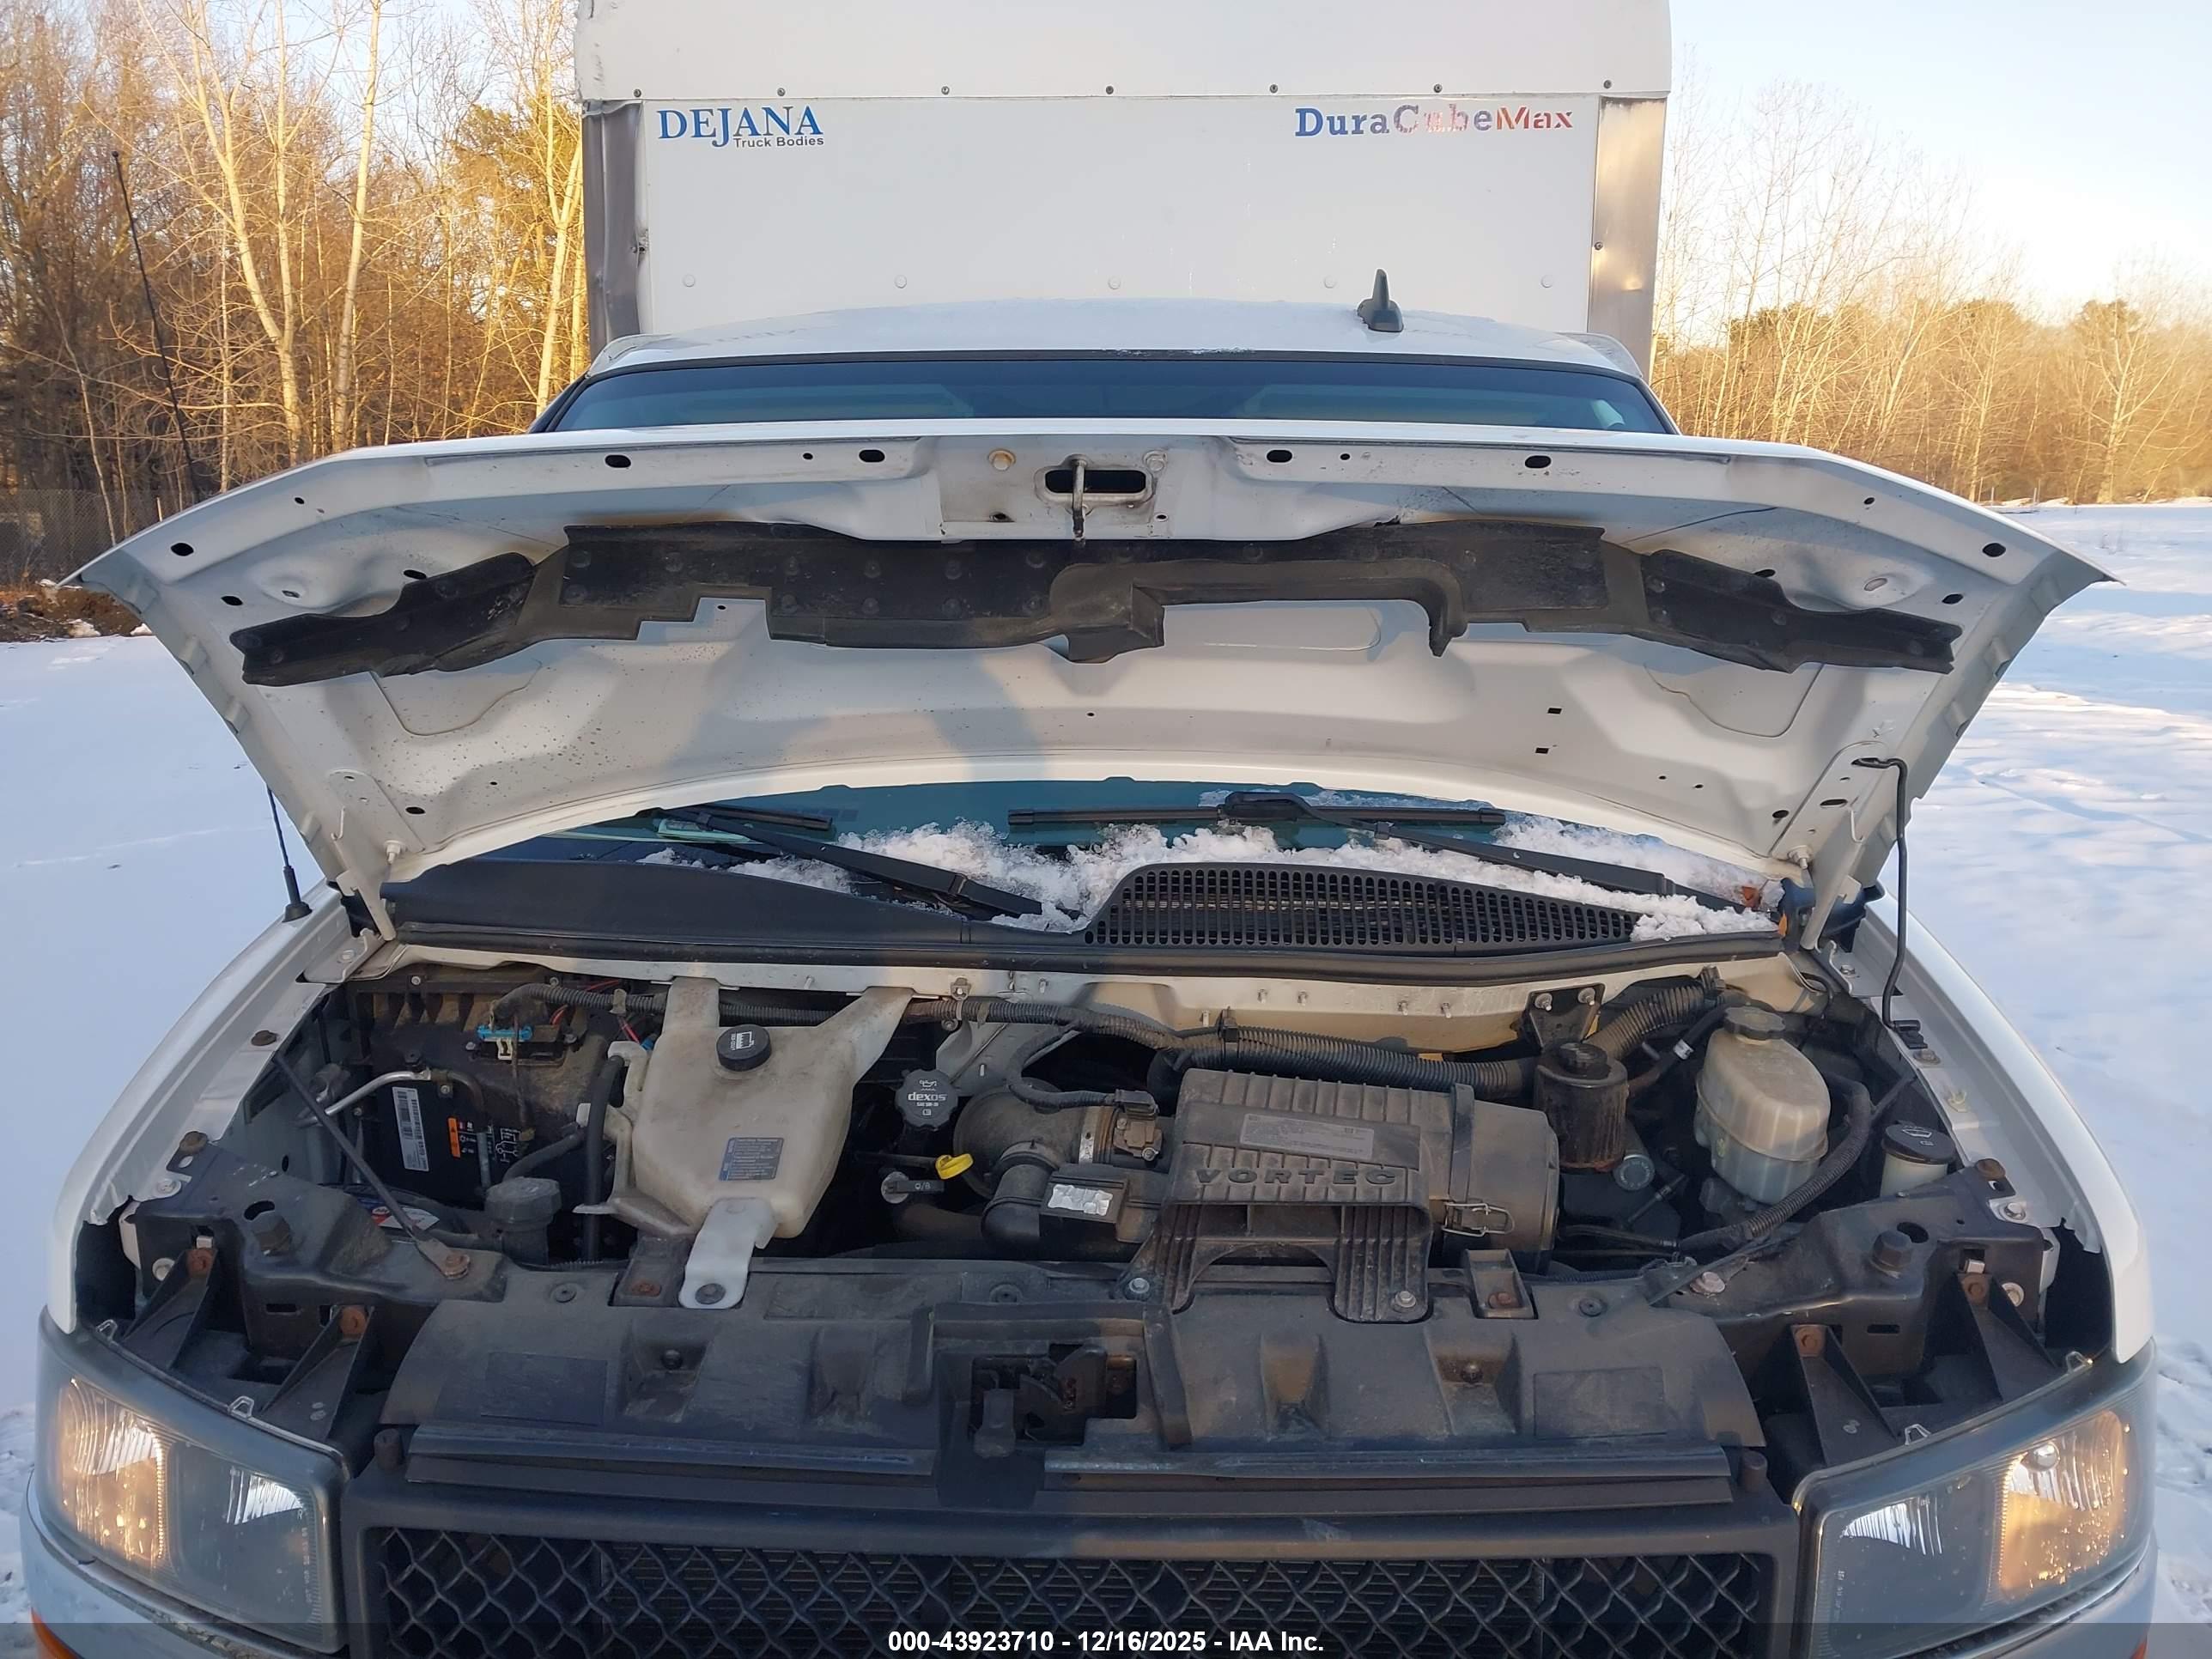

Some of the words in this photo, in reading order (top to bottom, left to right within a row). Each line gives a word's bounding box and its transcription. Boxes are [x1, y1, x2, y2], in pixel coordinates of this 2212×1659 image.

[657, 106, 824, 148] DEJANA
[734, 137, 772, 148] Truck
[777, 136, 824, 147] Bodies
[908, 1091, 948, 1101] dexos
[1195, 1168, 1395, 1185] VORTEC
